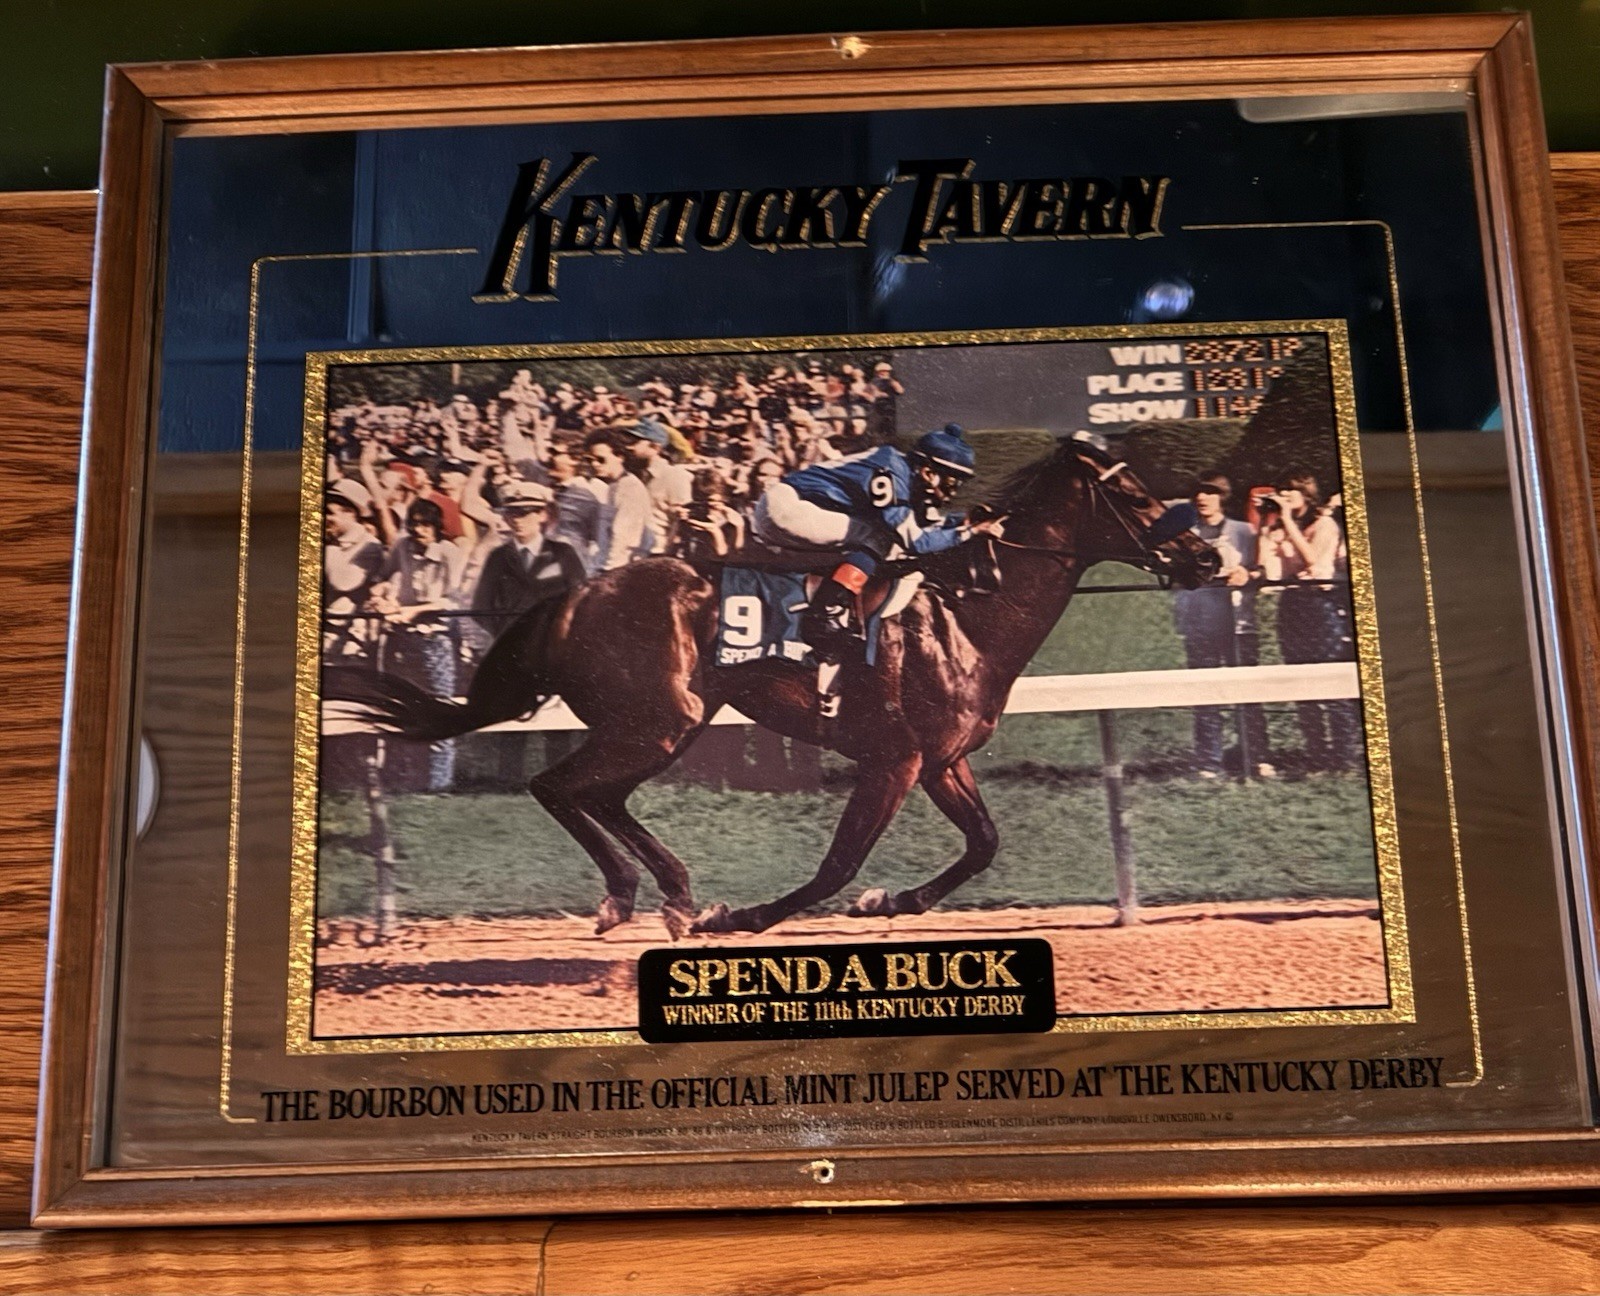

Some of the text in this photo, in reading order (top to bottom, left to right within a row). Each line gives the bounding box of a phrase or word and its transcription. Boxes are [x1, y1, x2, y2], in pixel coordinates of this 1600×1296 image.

[472, 152, 1171, 304] KENTUCKY TAVERN
[1109, 344, 1182, 366] WIN
[1087, 371, 1185, 395] PLACE
[1088, 399, 1187, 424] SHOW
[869, 475, 893, 508] 9
[723, 595, 762, 647] 9
[669, 949, 1021, 998] SPEND A BUCK
[662, 994, 1026, 1026] WINNER OF THE 111th KENTUCKY DERBY
[261, 1057, 1445, 1123] THE BOURBON USED IN THE OFFICIAL MINT JULEP SERVED AT THE KENTUCKY DERBY
[471, 1132, 517, 1142] KENTUCKY
[518, 1131, 550, 1141] TAVERN
[551, 1129, 592, 1140] STRAIGHT
[593, 1127, 635, 1138] BOURBON
[762, 1123, 800, 1133] BOTTLED
[898, 1118, 936, 1130] BOTTLED
[951, 1117, 997, 1129] GLENMORE
